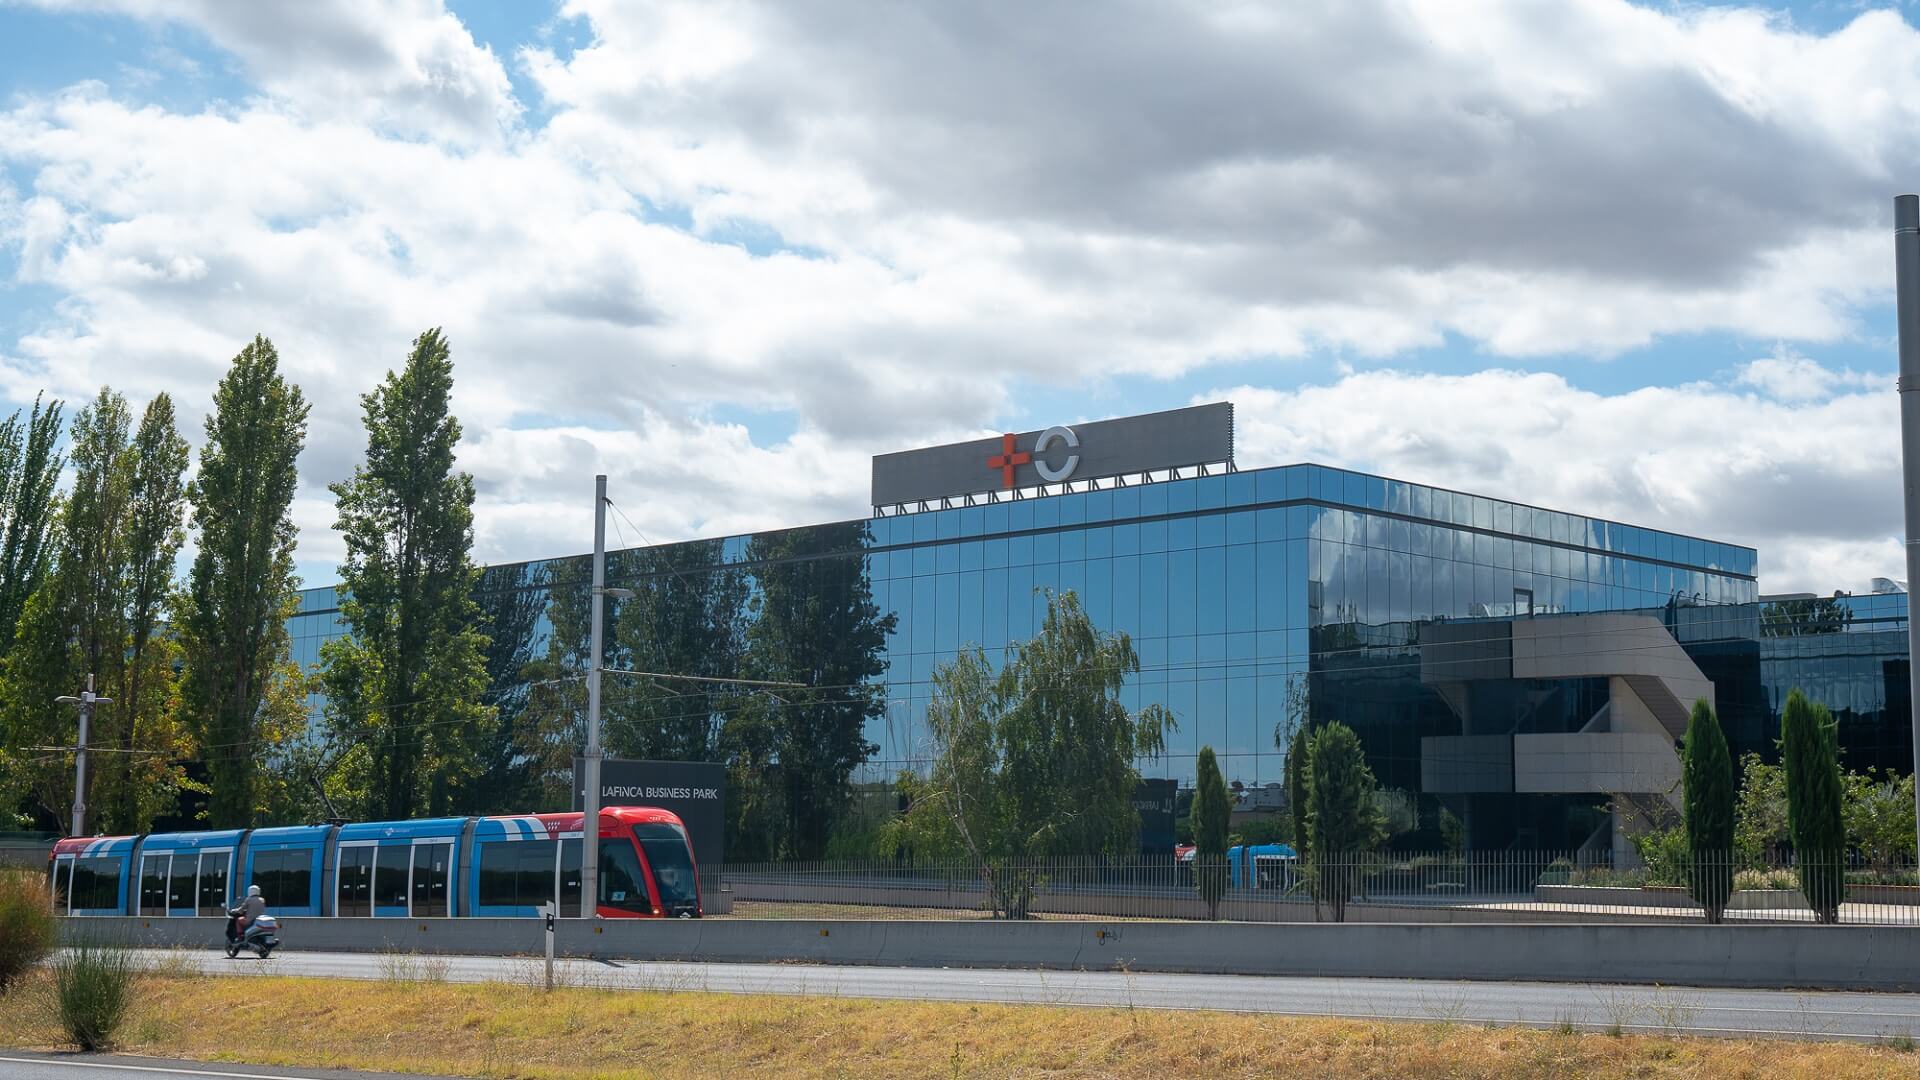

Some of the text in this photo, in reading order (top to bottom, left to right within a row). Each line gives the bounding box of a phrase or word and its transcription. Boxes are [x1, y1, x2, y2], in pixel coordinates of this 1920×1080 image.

[602, 786, 718, 799] LAFINCA BUSINESS PARK
